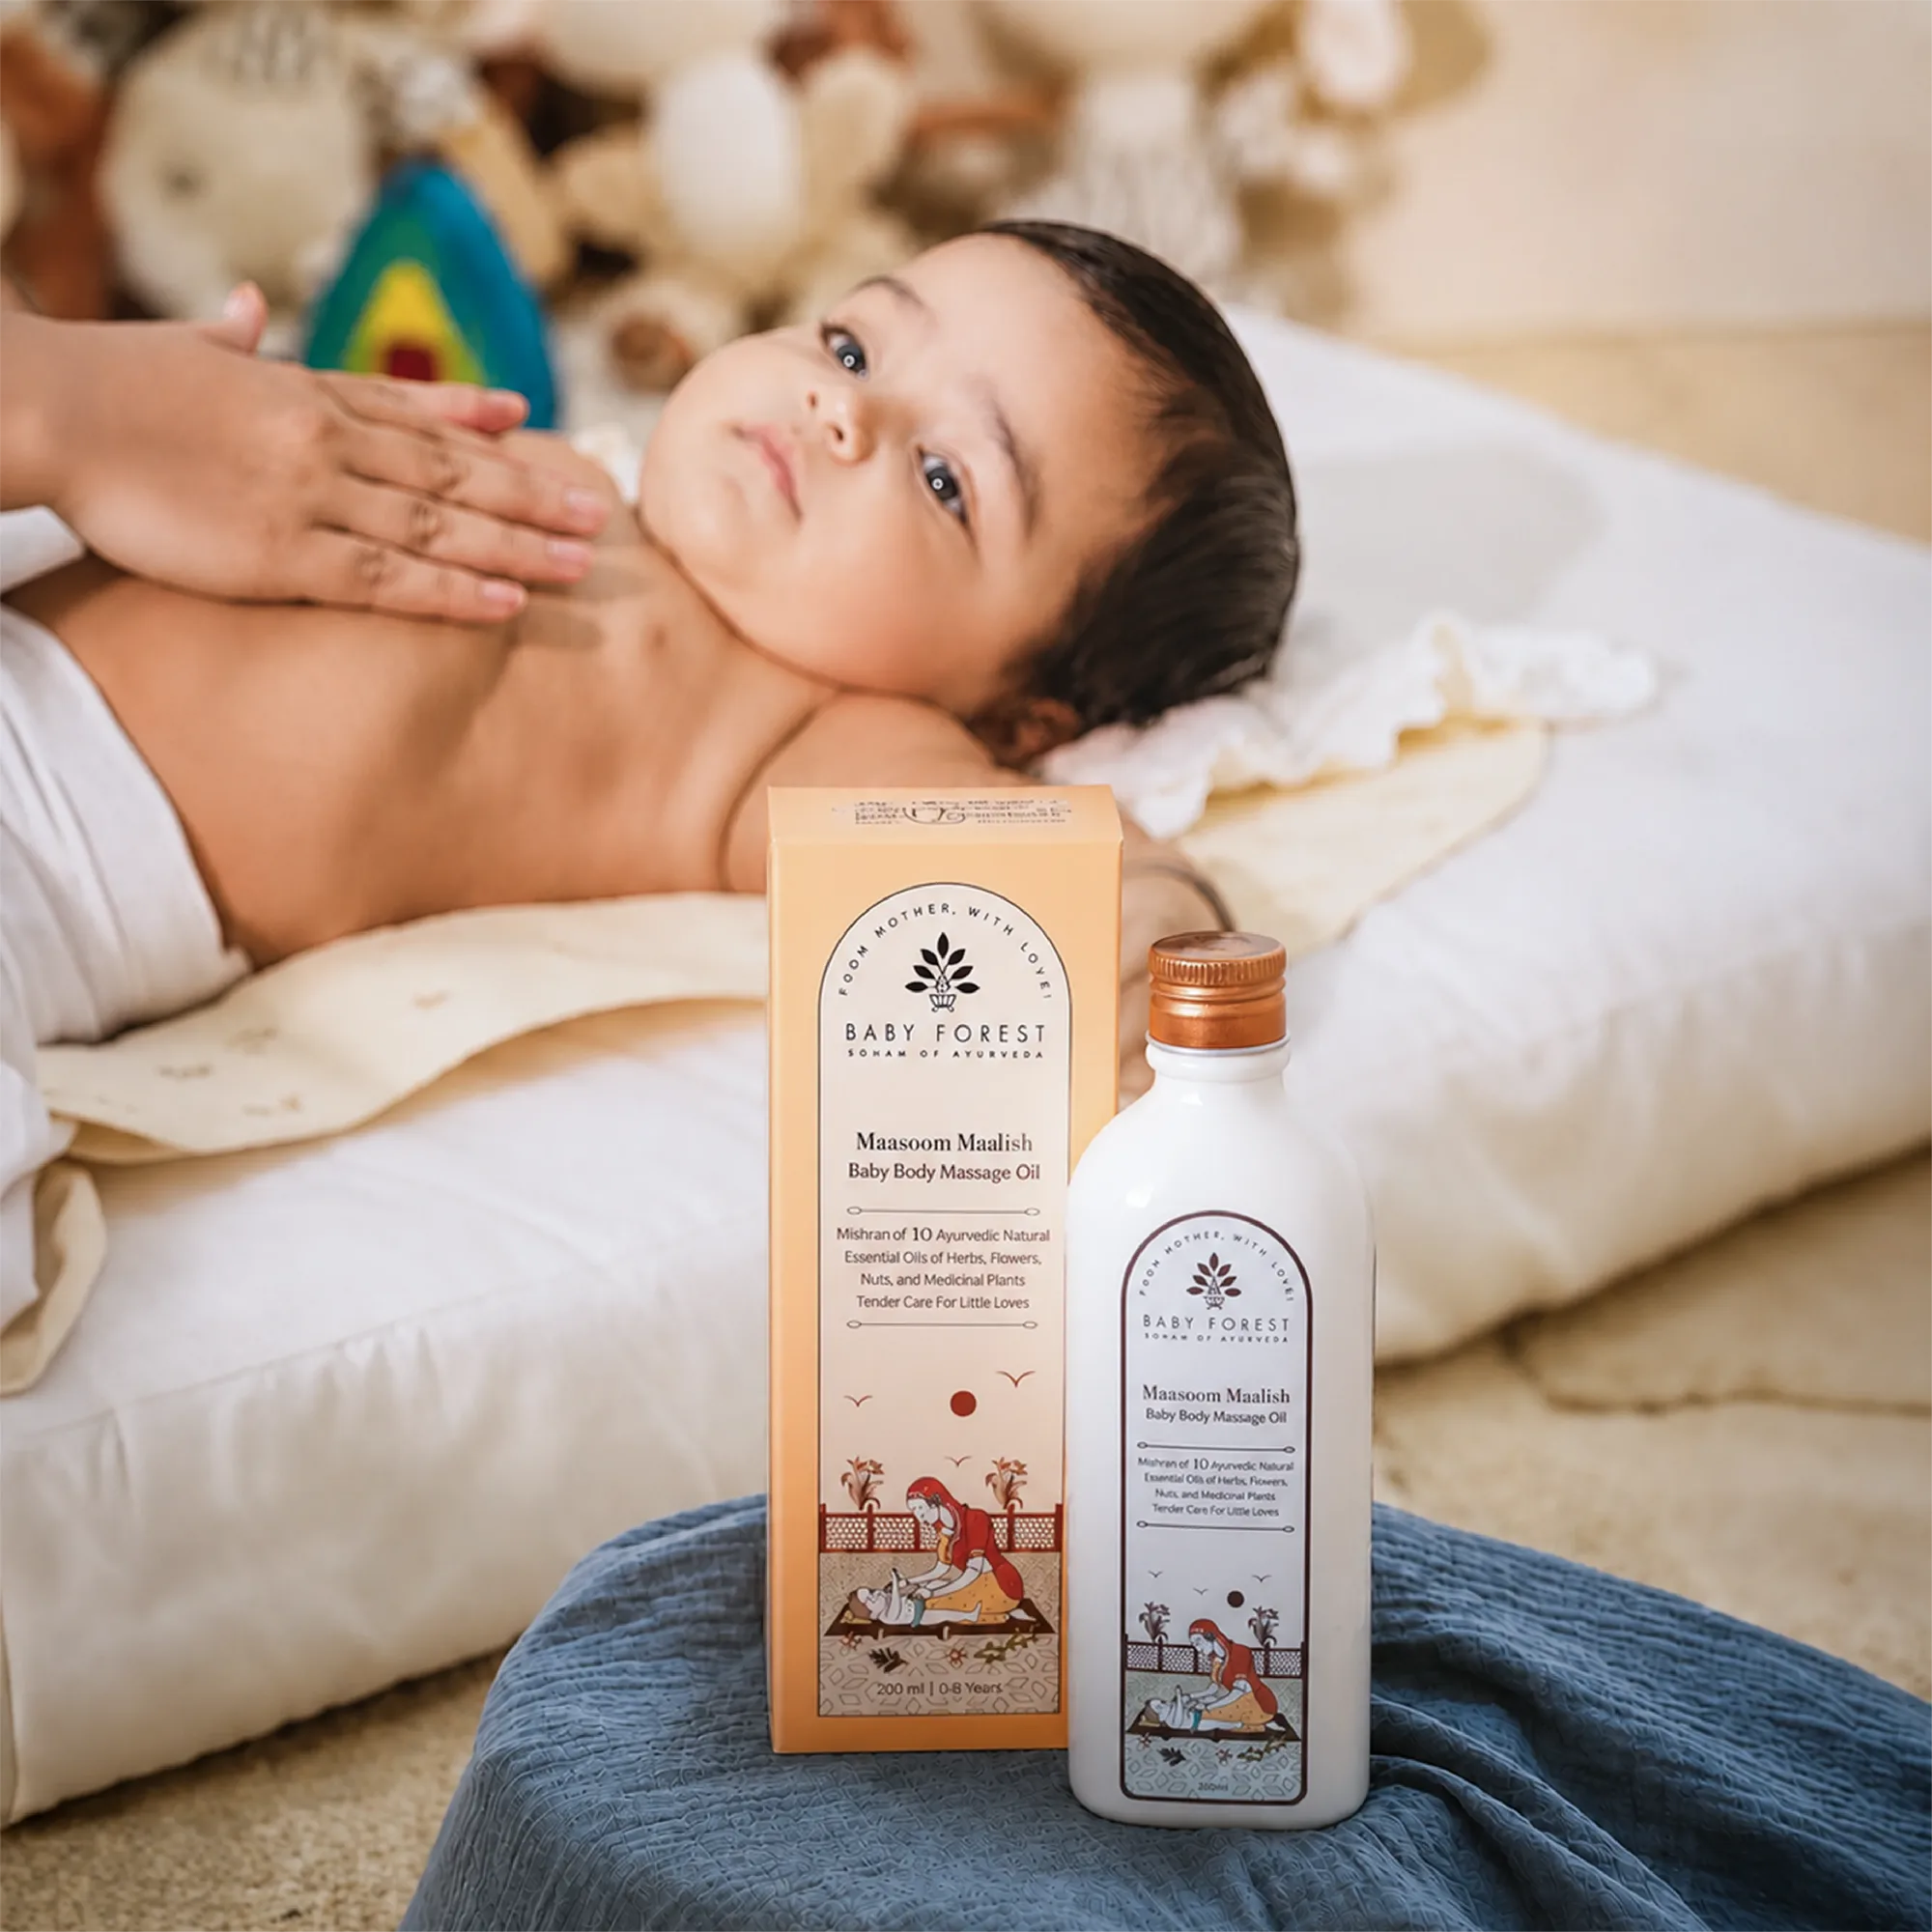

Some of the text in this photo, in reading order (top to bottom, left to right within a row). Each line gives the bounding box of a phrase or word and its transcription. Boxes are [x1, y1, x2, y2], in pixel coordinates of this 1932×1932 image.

[968, 906, 1013, 936] WITH
[846, 1023, 1044, 1042] BABY FOREST
[848, 1049, 1043, 1059] SOHAM OF AYURVEDA
[856, 1131, 1033, 1151] Maasoom Maalish
[848, 1162, 1041, 1184] Baby Body Massage Oil
[837, 1227, 1051, 1244] Mishran of 10 Ayurvedic Natural
[1233, 1234, 1267, 1256] WITH
[844, 1250, 1042, 1265] Essential Oils of Herbs, Flowers,
[860, 1273, 1026, 1287] Nuts, and Medicinal Plants
[856, 1294, 1030, 1309] Tender Care For Little Loves
[1143, 1314, 1290, 1332] BABY FOREST
[1143, 1383, 1291, 1404] Maasoom Maalish
[1146, 1407, 1288, 1426] Baby Body Massage Oil
[1179, 1459, 1190, 1469] of
[1193, 1458, 1209, 1470] 10
[1210, 1460, 1256, 1472] Ayurvedic
[1259, 1461, 1294, 1471] Natural
[1206, 1475, 1217, 1485] of
[1181, 1490, 1199, 1499] and
[1202, 1491, 1245, 1500] Medicinal
[1247, 1491, 1276, 1501] Plants
[1151, 1503, 1280, 1517] Tender Care For Little Loves
[876, 1682, 903, 1695] 200
[906, 1682, 924, 1695] ml
[939, 1682, 962, 1694] 0-8
[965, 1682, 1004, 1694] Years
